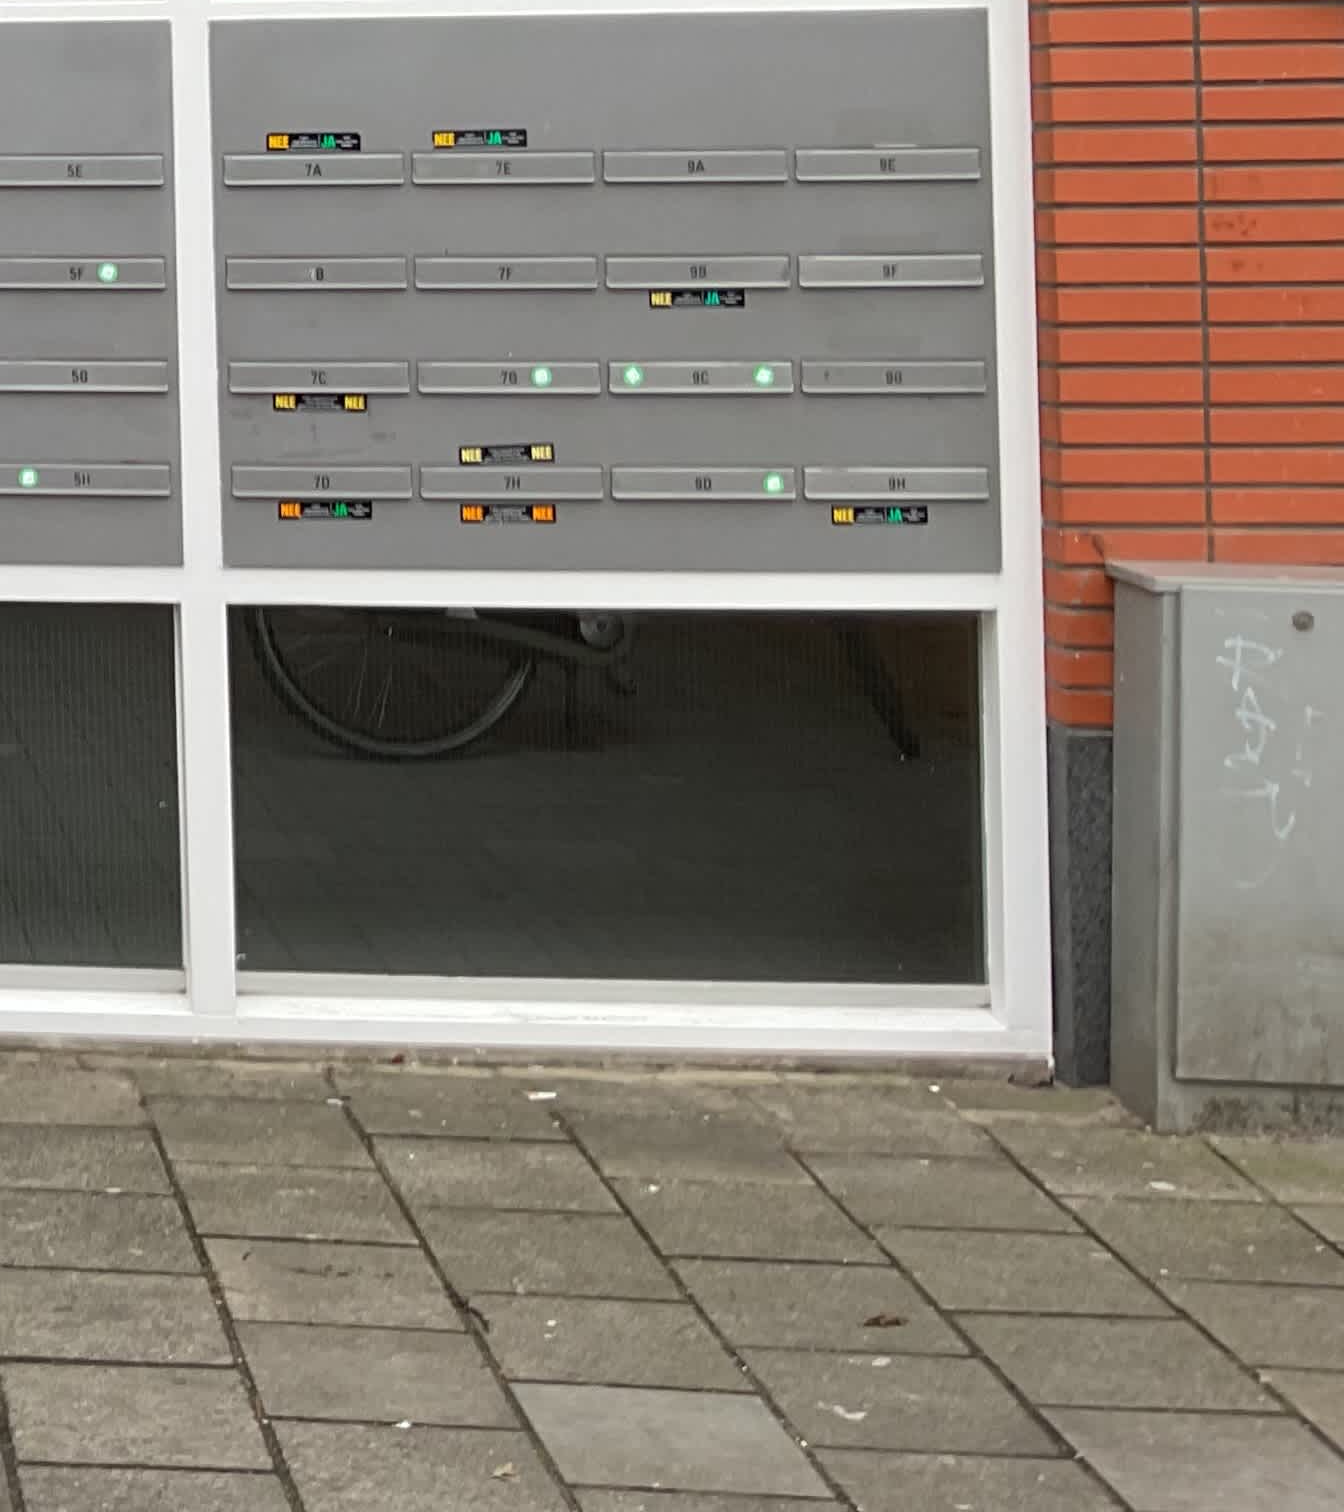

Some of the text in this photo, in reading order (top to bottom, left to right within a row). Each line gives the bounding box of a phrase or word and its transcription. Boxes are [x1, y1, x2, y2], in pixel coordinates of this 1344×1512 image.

[321, 136, 336, 148] JA
[434, 133, 454, 146] NEE
[488, 132, 501, 144] JA
[66, 163, 84, 179] 5E
[304, 162, 323, 177] 7A
[495, 159, 512, 176] 7E
[704, 291, 720, 305] JA
[310, 369, 327, 385] 7C
[503, 475, 521, 491] 7H
[333, 503, 348, 517] JA
